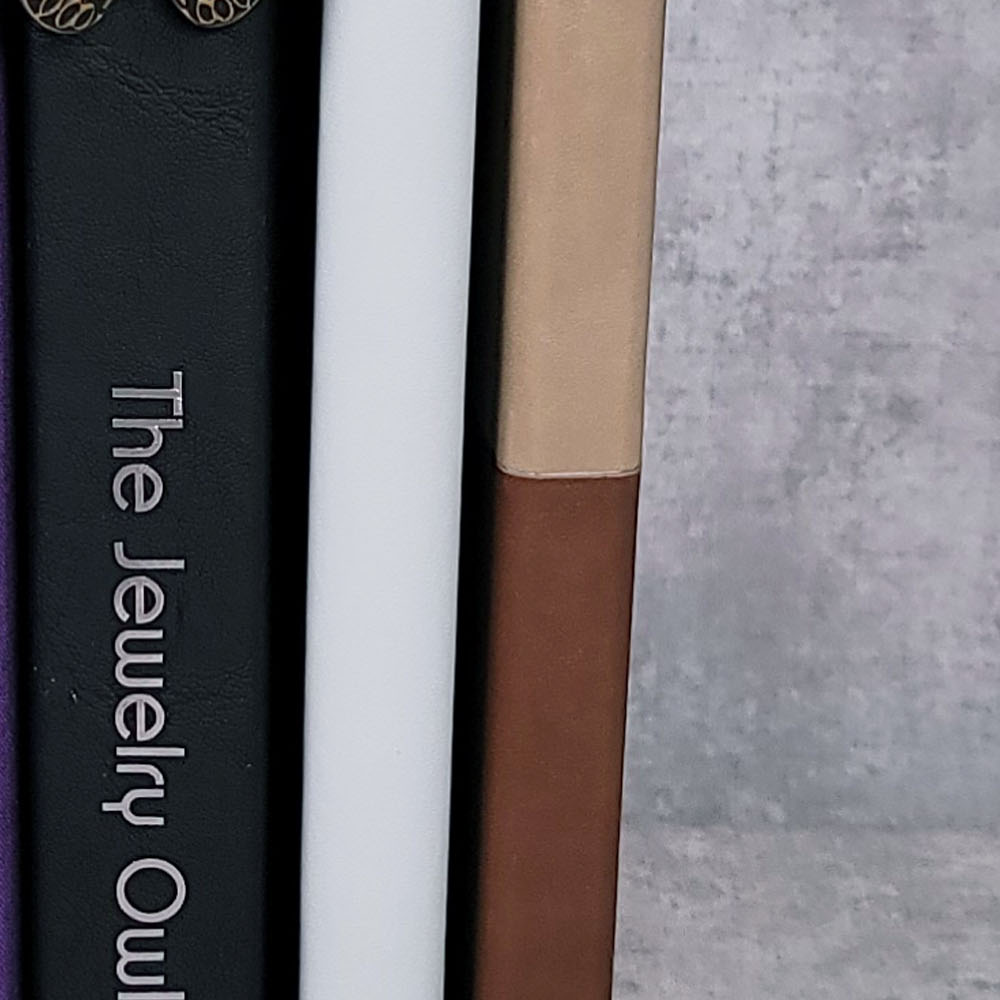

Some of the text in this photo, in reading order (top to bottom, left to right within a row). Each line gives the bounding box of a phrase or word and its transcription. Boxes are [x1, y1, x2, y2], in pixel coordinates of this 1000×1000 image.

[102, 371, 186, 1000] The Jewelry Owl
